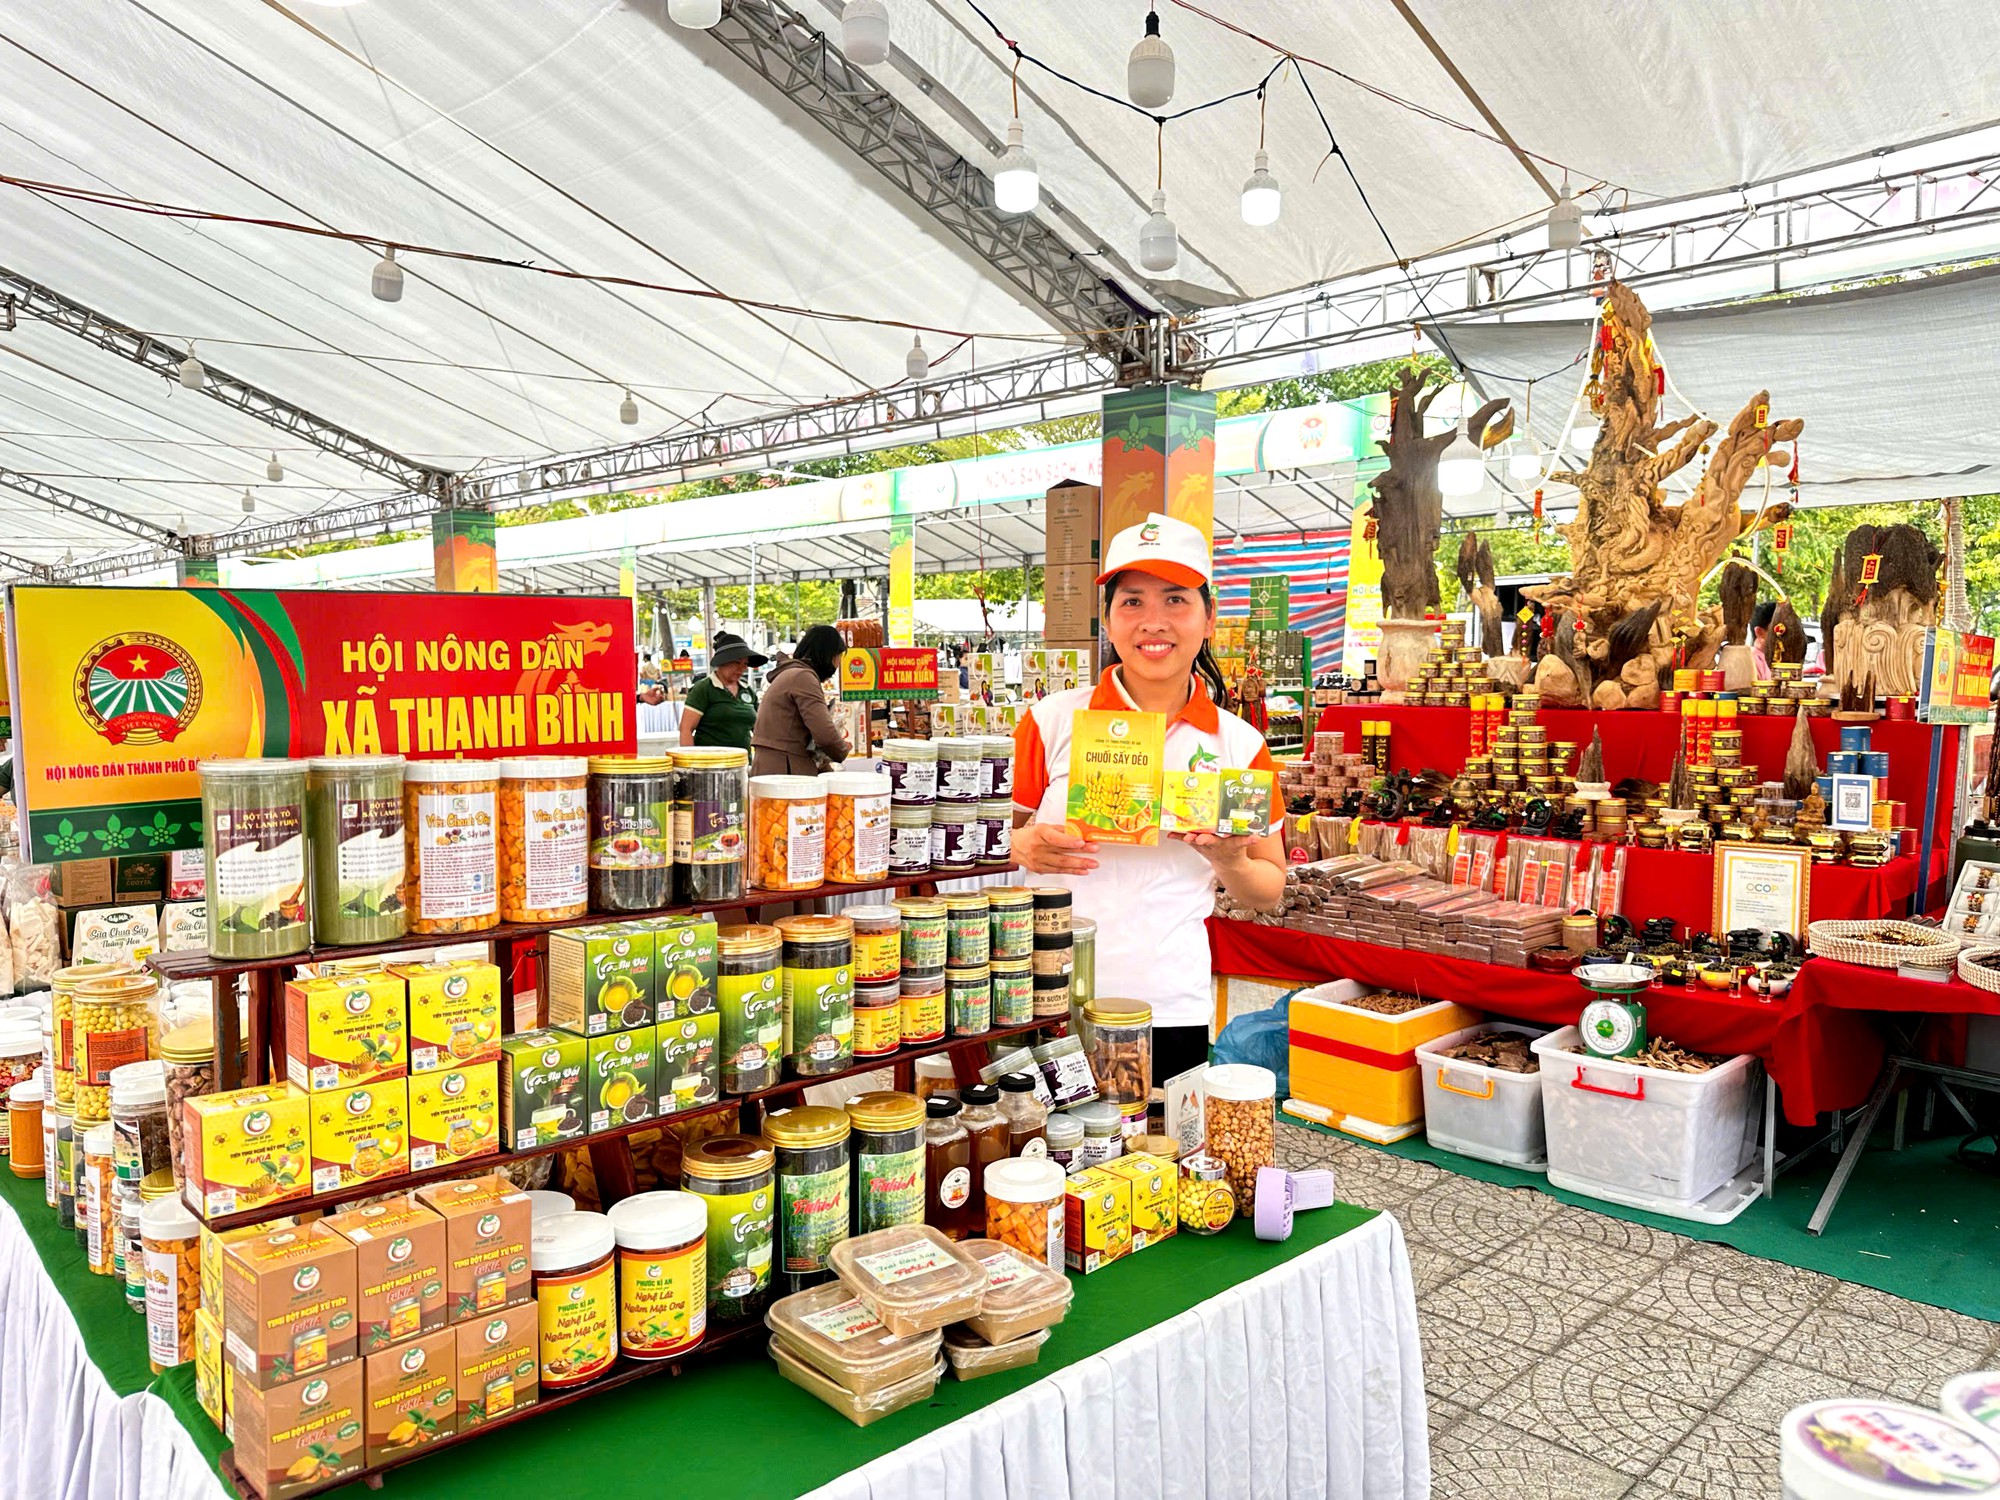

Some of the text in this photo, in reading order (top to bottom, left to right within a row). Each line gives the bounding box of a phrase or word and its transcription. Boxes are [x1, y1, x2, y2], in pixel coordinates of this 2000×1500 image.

[342, 632, 585, 682] HỘI NÔNG DÂN
[883, 668, 895, 684] XÃ
[321, 683, 625, 760] XÃ THẠNH BÌNH
[1086, 750, 1148, 766] CHUỐI SẤY DẺO
[45, 766, 69, 781] HỘI
[69, 764, 100, 779] NÔNG
[102, 764, 125, 777] DÂN
[127, 761, 163, 776] THÀNH
[165, 757, 187, 774] PHỐ
[243, 812, 261, 822] BỘT
[264, 811, 278, 819] TÍA
[425, 814, 447, 828] Viên
[447, 813, 474, 828] Chanh
[553, 808, 575, 821] Chanh
[235, 820, 254, 830] SẤY
[1746, 883, 1778, 893] OCOP
[635, 1290, 674, 1302] Nghệ Lát
[624, 1301, 685, 1314] Ngâm Mật Ong
[557, 1310, 597, 1330] Nghệ Lát
[544, 1320, 607, 1343] Ngâm Mật Ong
